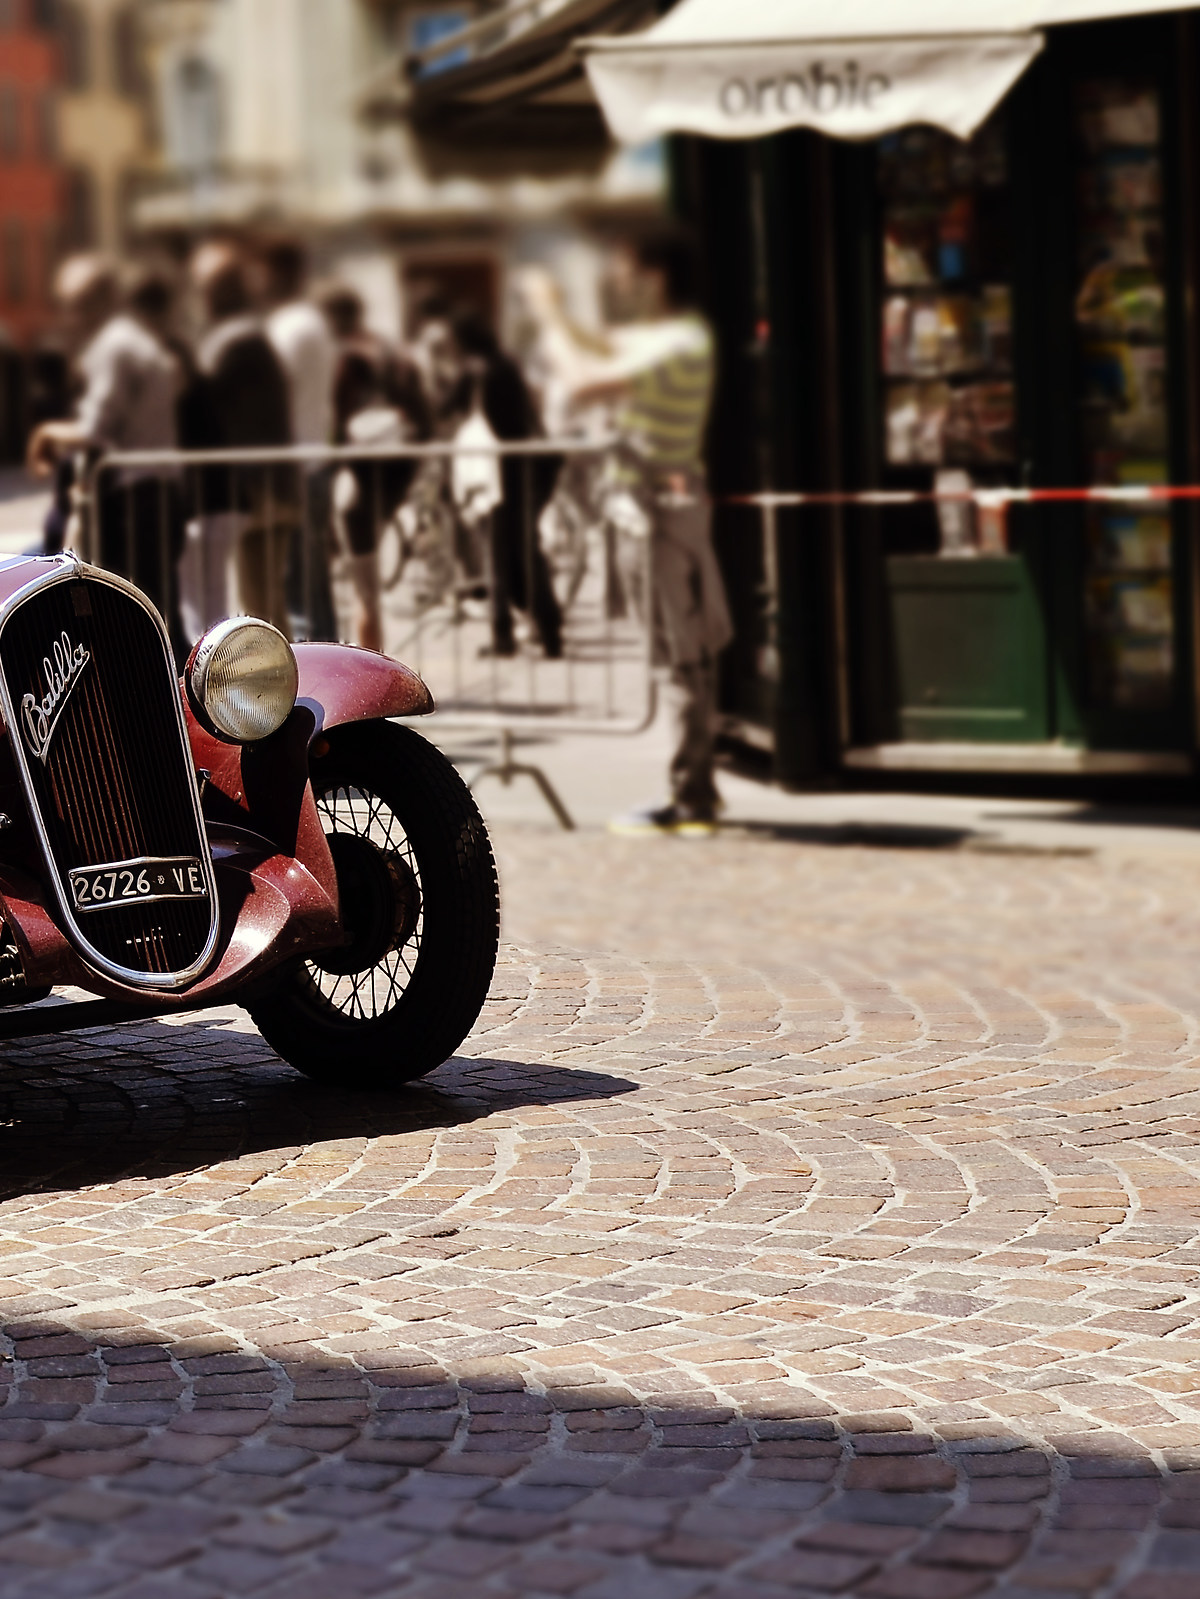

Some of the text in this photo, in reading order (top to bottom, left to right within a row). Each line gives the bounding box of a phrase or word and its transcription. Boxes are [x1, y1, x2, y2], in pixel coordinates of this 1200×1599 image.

[21, 631, 90, 766] Balilla
[74, 867, 202, 903] 26726 VE
